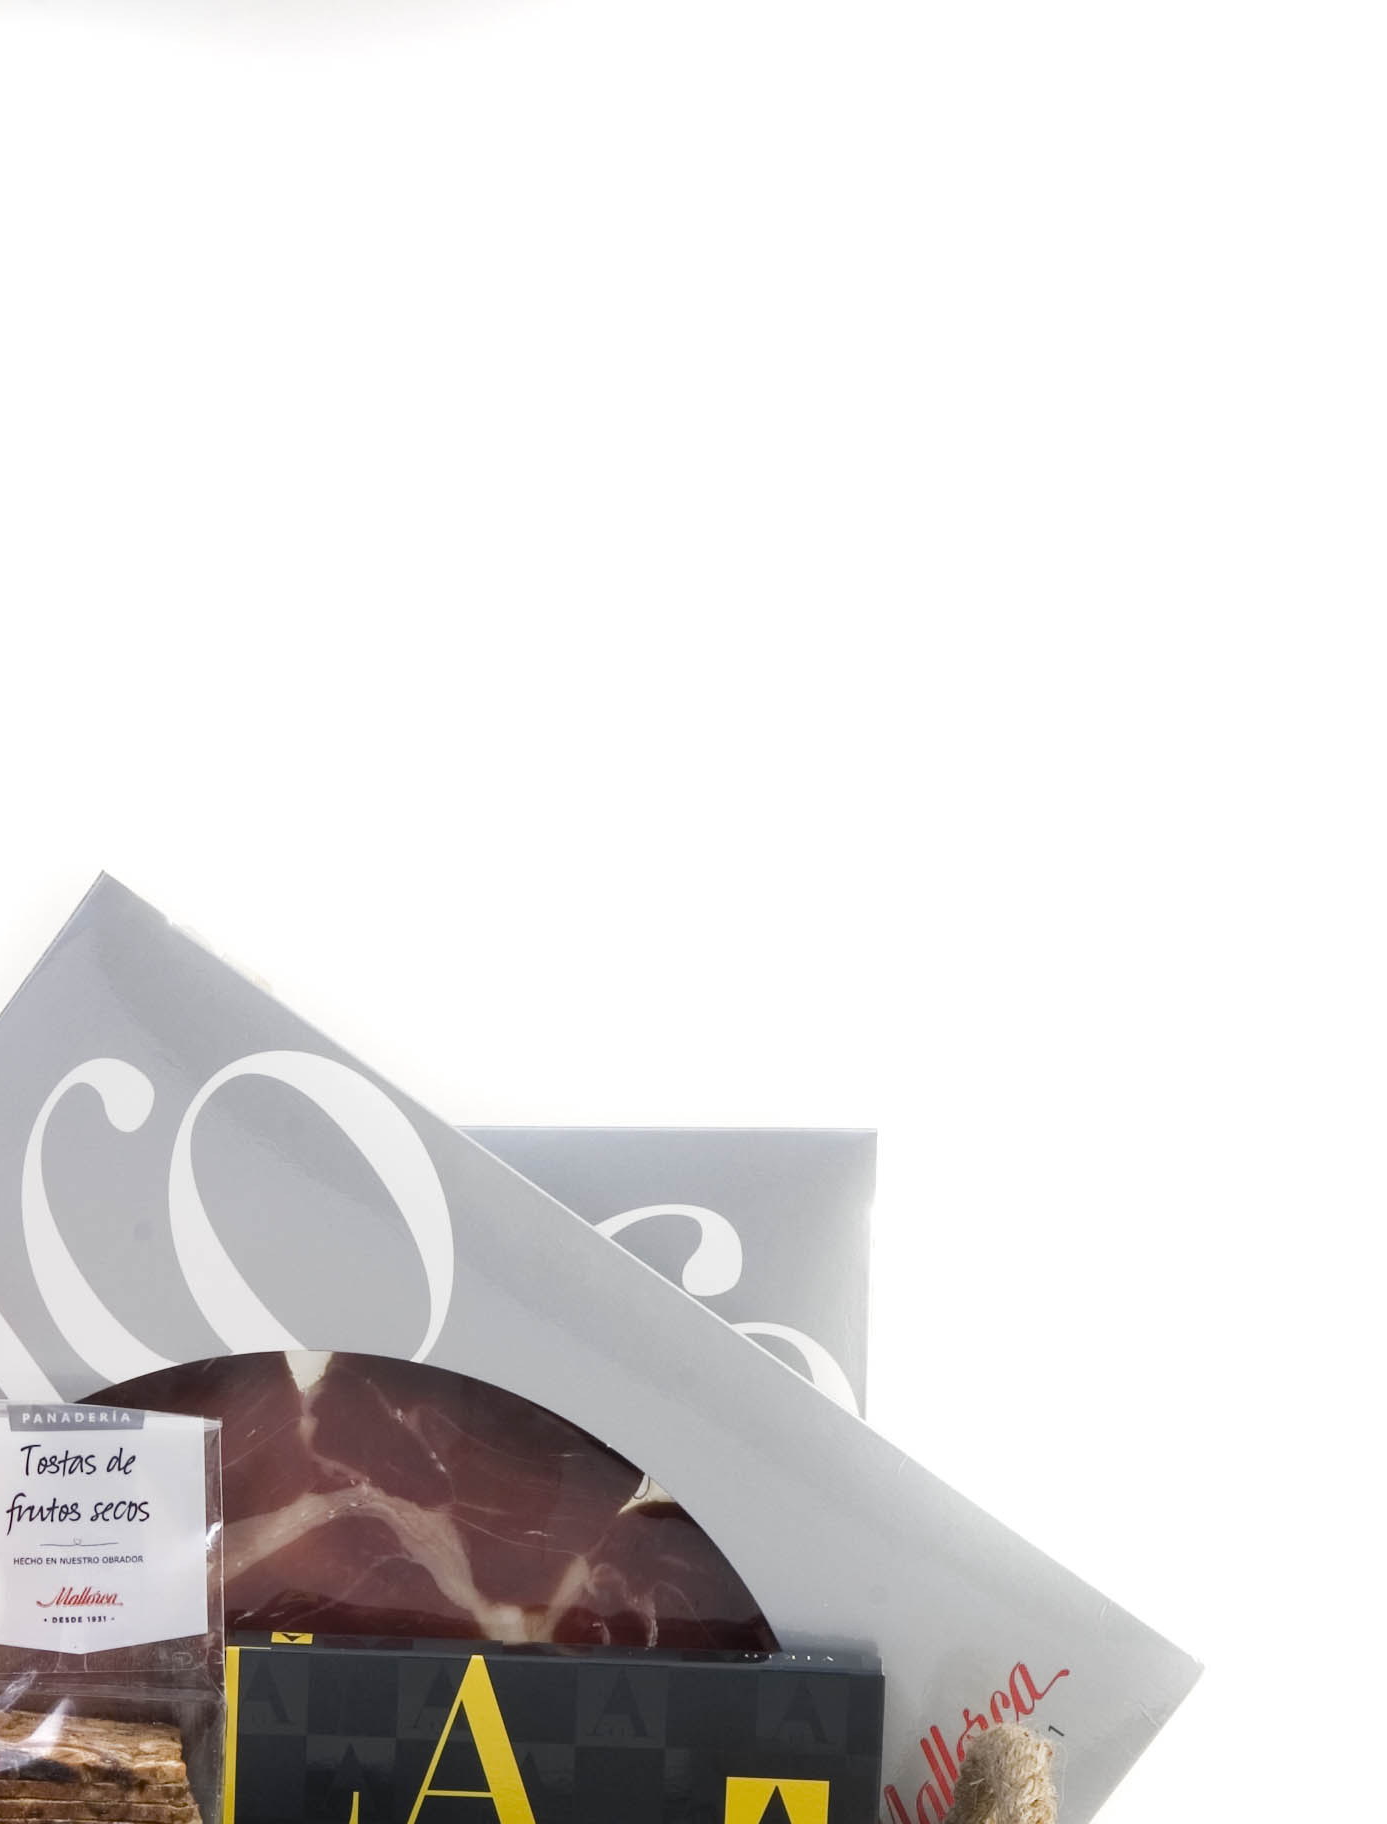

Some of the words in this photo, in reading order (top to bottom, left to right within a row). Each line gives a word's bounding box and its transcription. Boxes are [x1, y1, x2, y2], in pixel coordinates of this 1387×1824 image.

[22, 1410, 131, 1424] PANADERÍA
[20, 1444, 97, 1477] Tostas
[106, 1447, 136, 1475] de
[5, 1492, 81, 1536] frutos
[90, 1500, 150, 1523] secos
[13, 1557, 43, 1565] HECHO
[46, 1557, 57, 1565] EN
[59, 1556, 100, 1565] NUESTRO
[102, 1555, 144, 1564] OBRADOR
[36, 1585, 124, 1608] Mallorca
